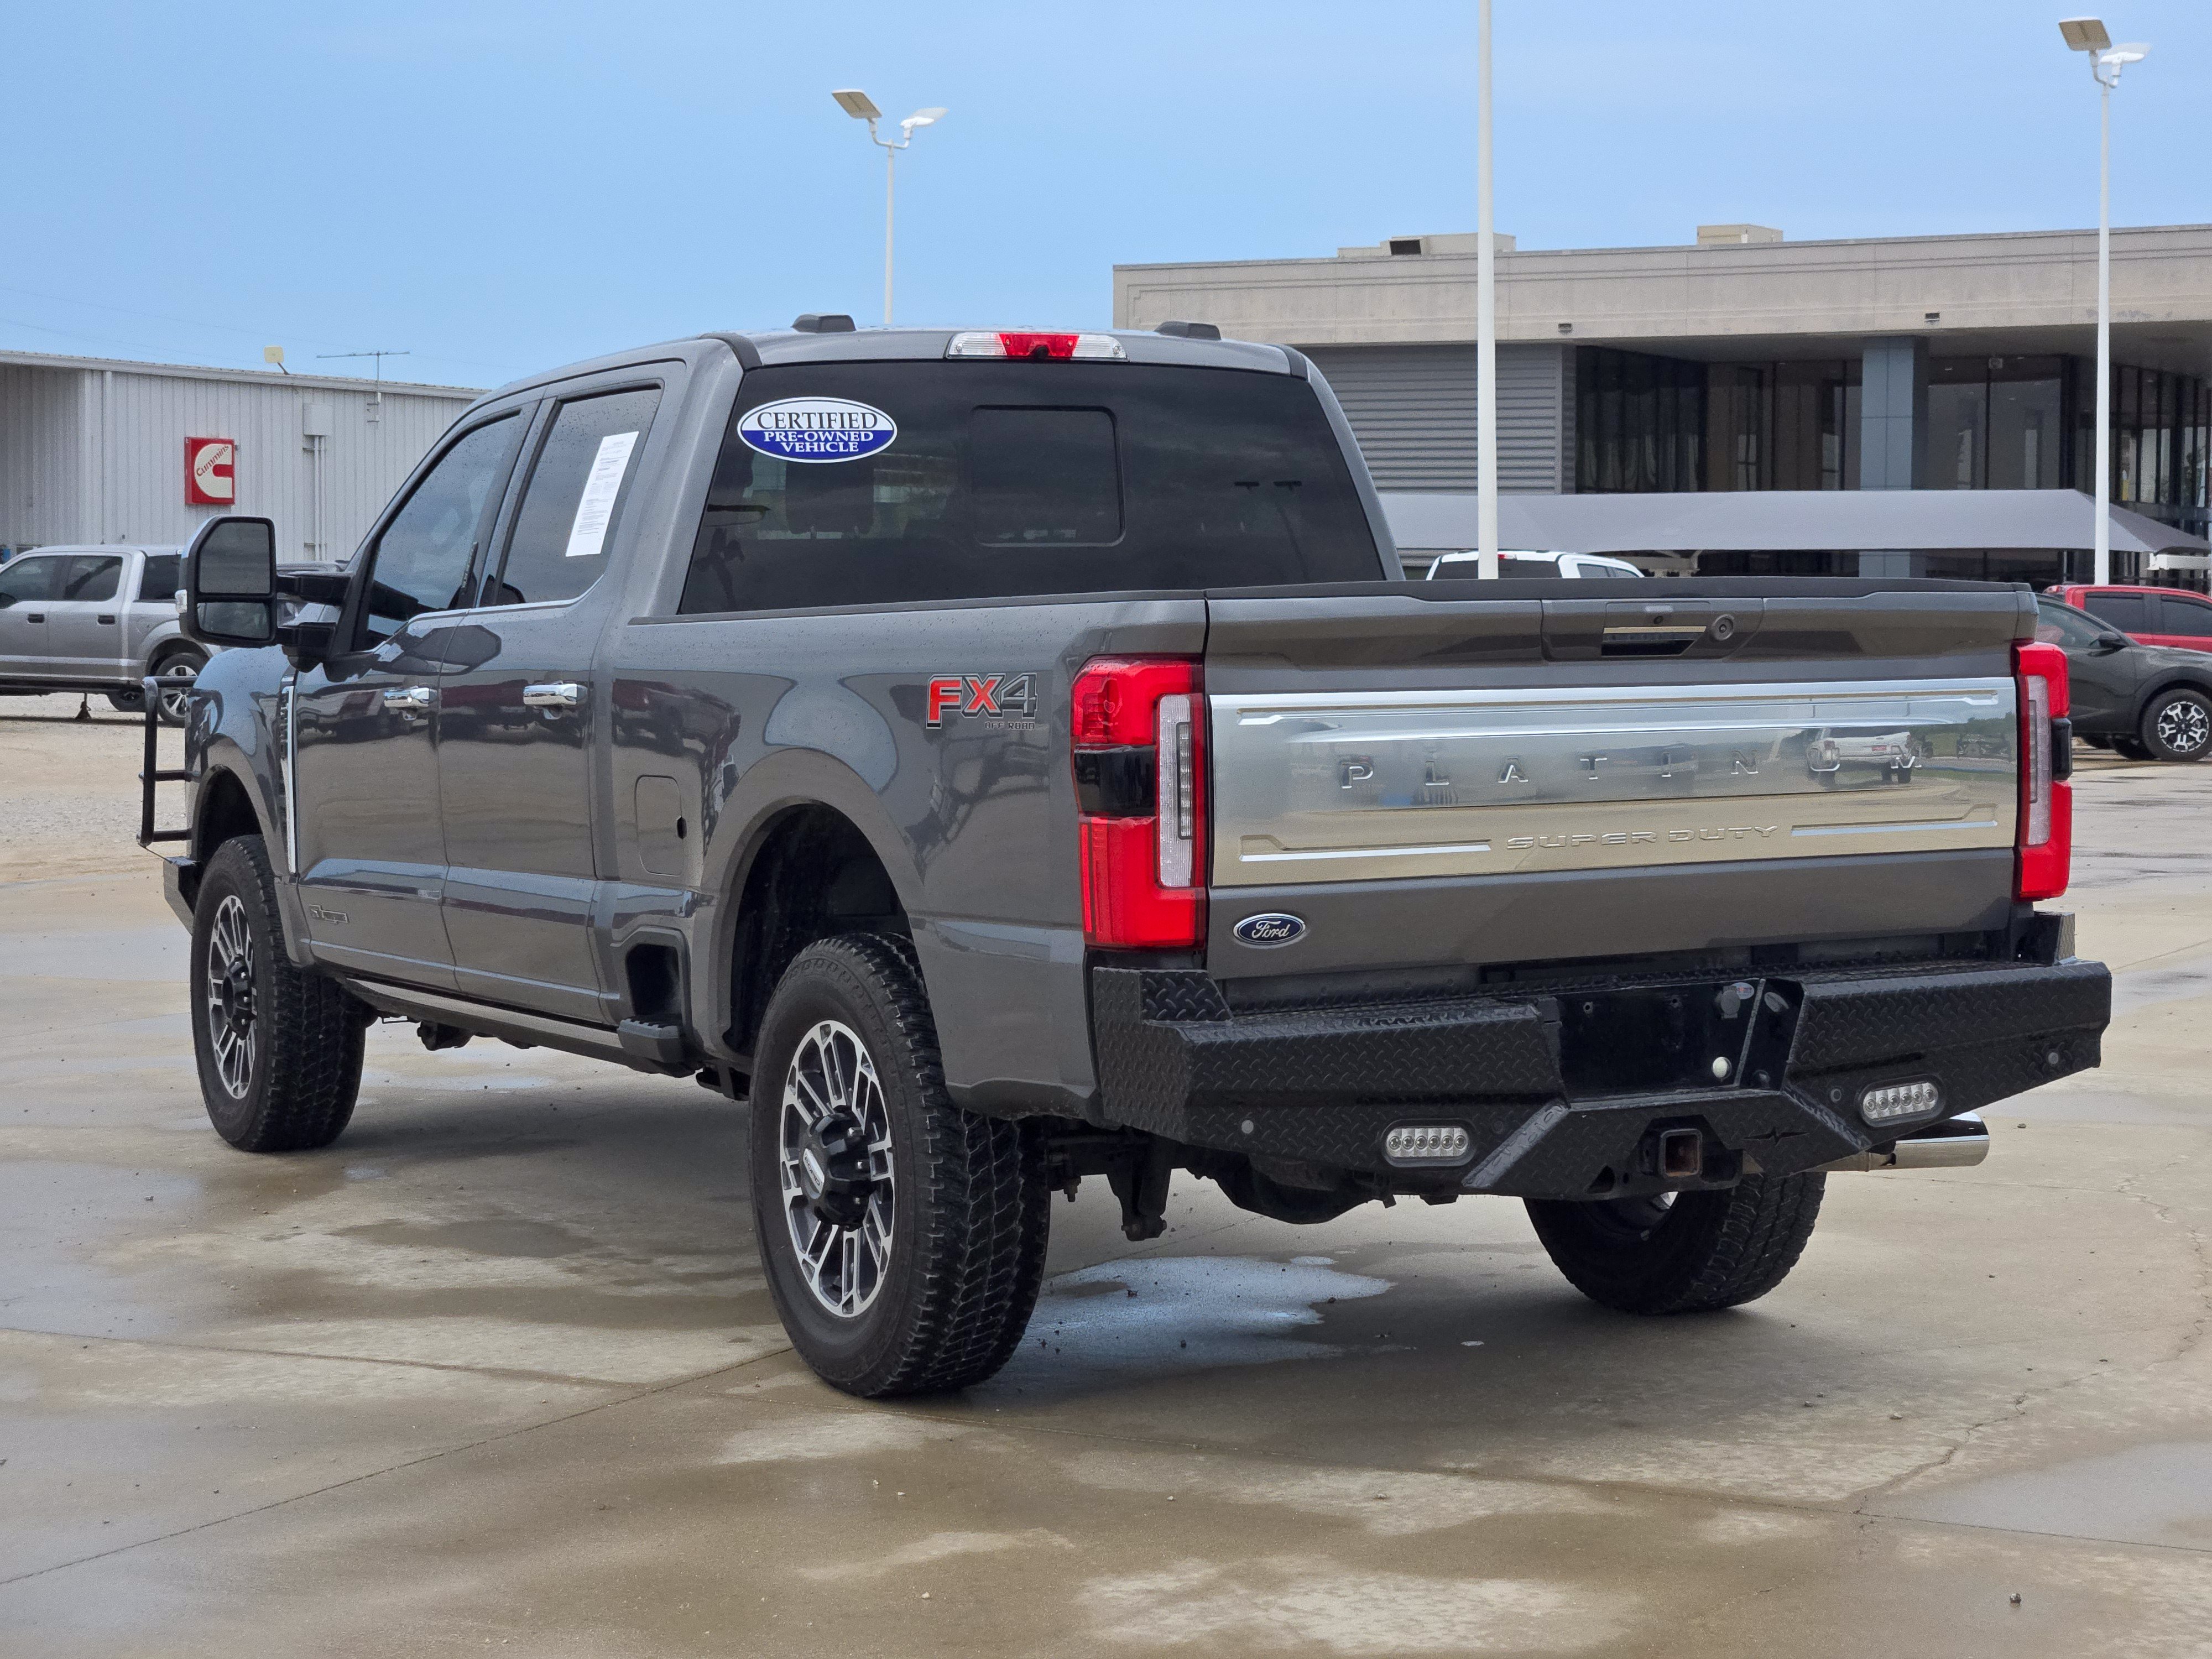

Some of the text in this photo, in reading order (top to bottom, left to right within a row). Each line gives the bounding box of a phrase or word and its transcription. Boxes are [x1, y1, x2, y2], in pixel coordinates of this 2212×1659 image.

[757, 411, 878, 430] CERTIFIED
[763, 431, 874, 442] PRE-OWNED
[782, 442, 859, 452] VEHICLE
[196, 445, 229, 477] Cummins
[926, 672, 1038, 729] FX4
[984, 721, 1035, 731] OFF ROAD
[1339, 744, 1923, 790] PLATINUM
[1507, 825, 1778, 850] SUPER DUTY
[1251, 920, 1291, 939] Ford
